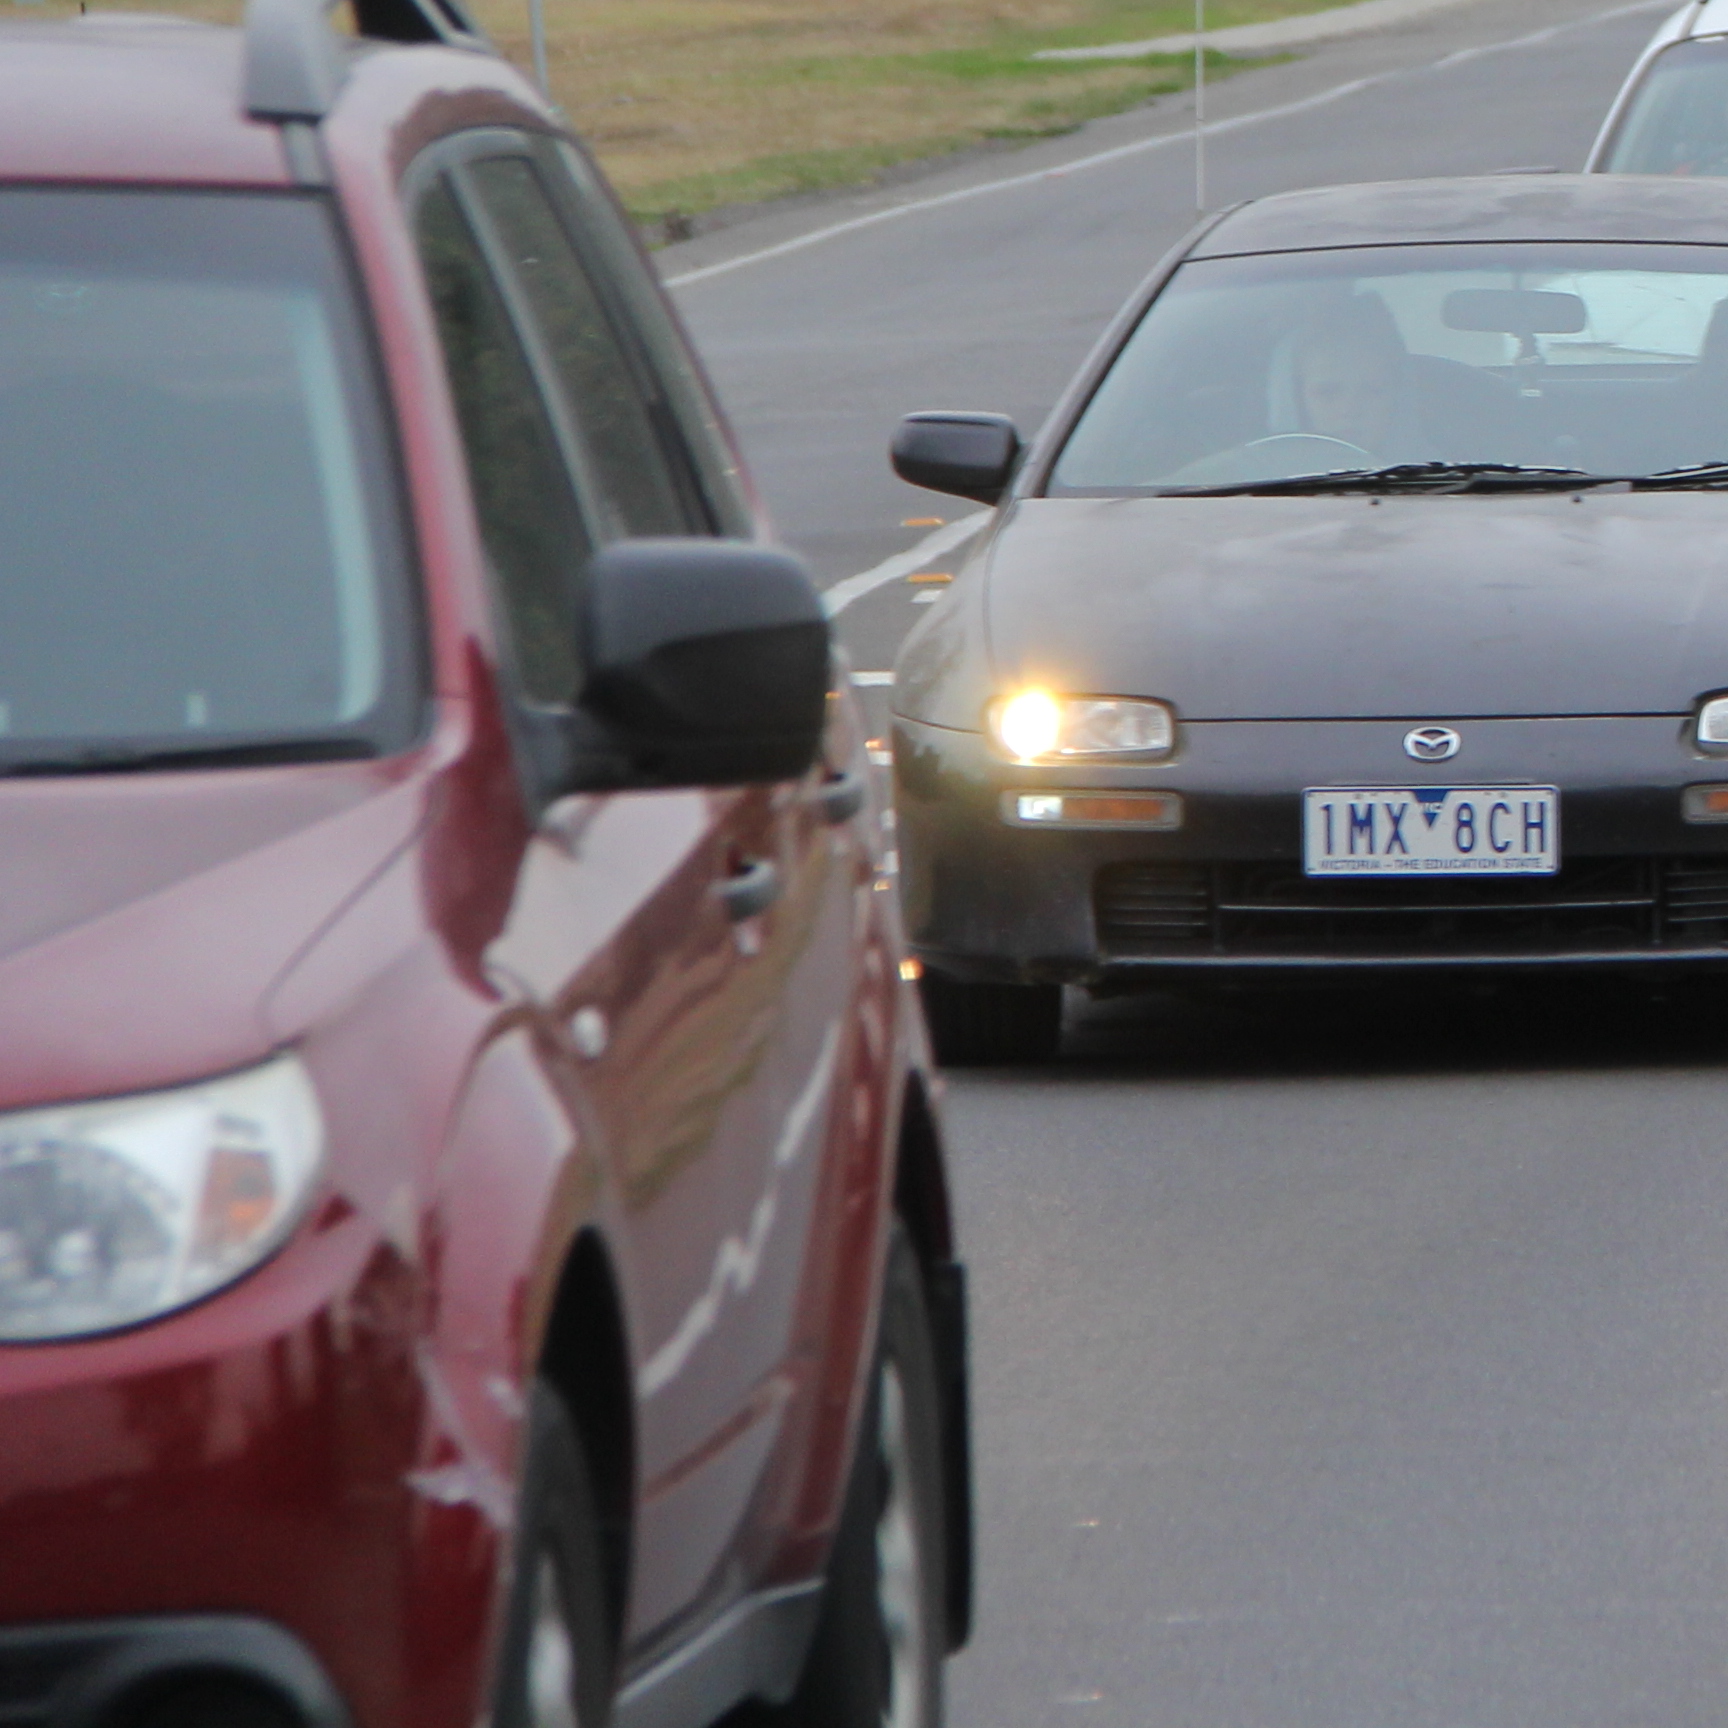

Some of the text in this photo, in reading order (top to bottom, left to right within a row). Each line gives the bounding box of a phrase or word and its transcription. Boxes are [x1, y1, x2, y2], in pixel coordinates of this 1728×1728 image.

[1319, 801, 1548, 856] 1MX 8CH
[1319, 858, 1382, 871] VICTORIA
[1394, 859, 1420, 870] THE
[1424, 858, 1499, 870] EDUCATION
[1503, 857, 1542, 869] STATE
